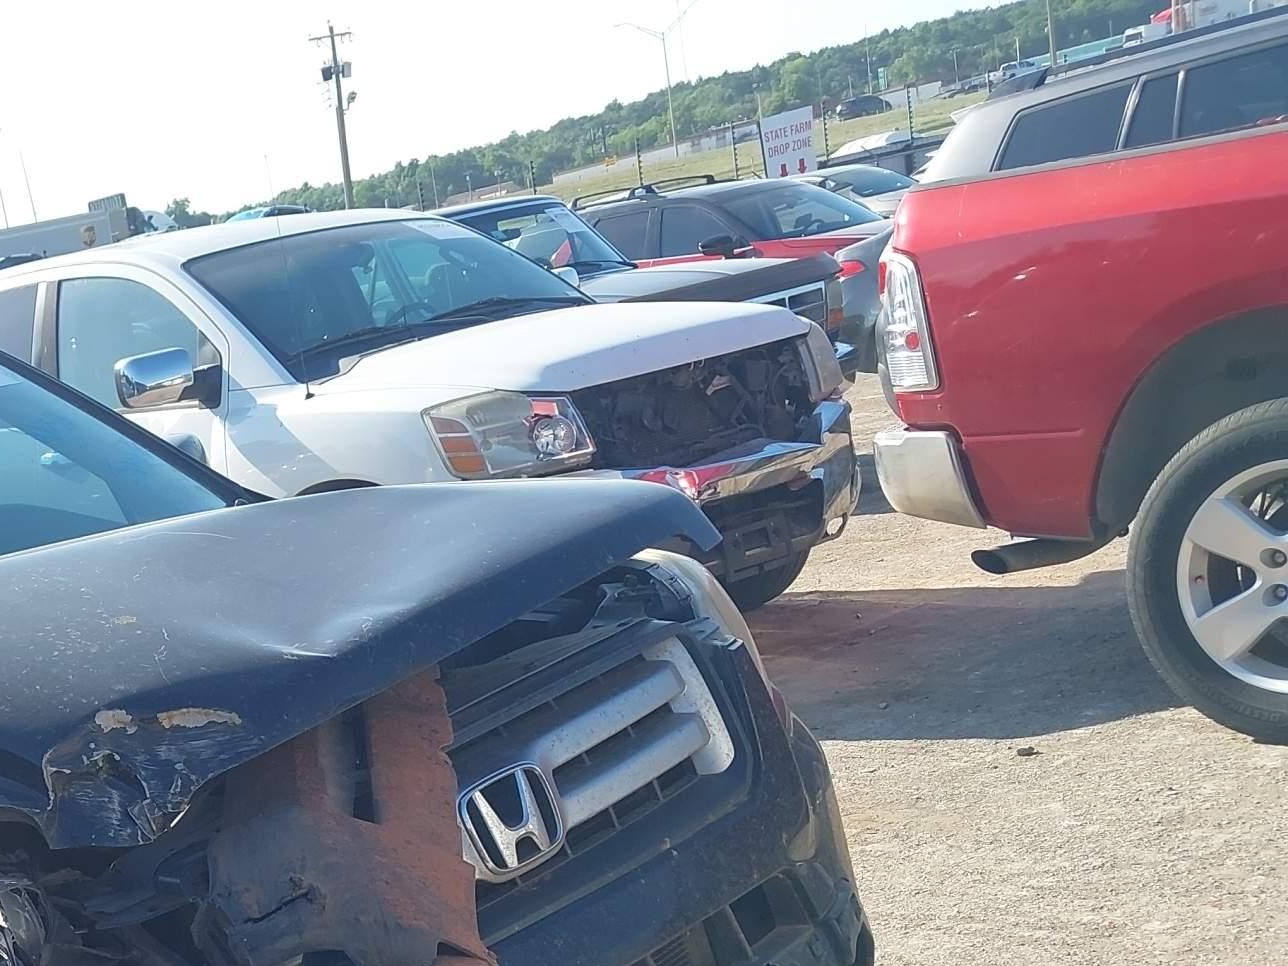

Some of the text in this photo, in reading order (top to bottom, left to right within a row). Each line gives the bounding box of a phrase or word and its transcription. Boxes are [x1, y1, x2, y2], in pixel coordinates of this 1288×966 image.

[765, 121, 811, 142] STATE FARM
[768, 137, 811, 157] DROP ZONE
